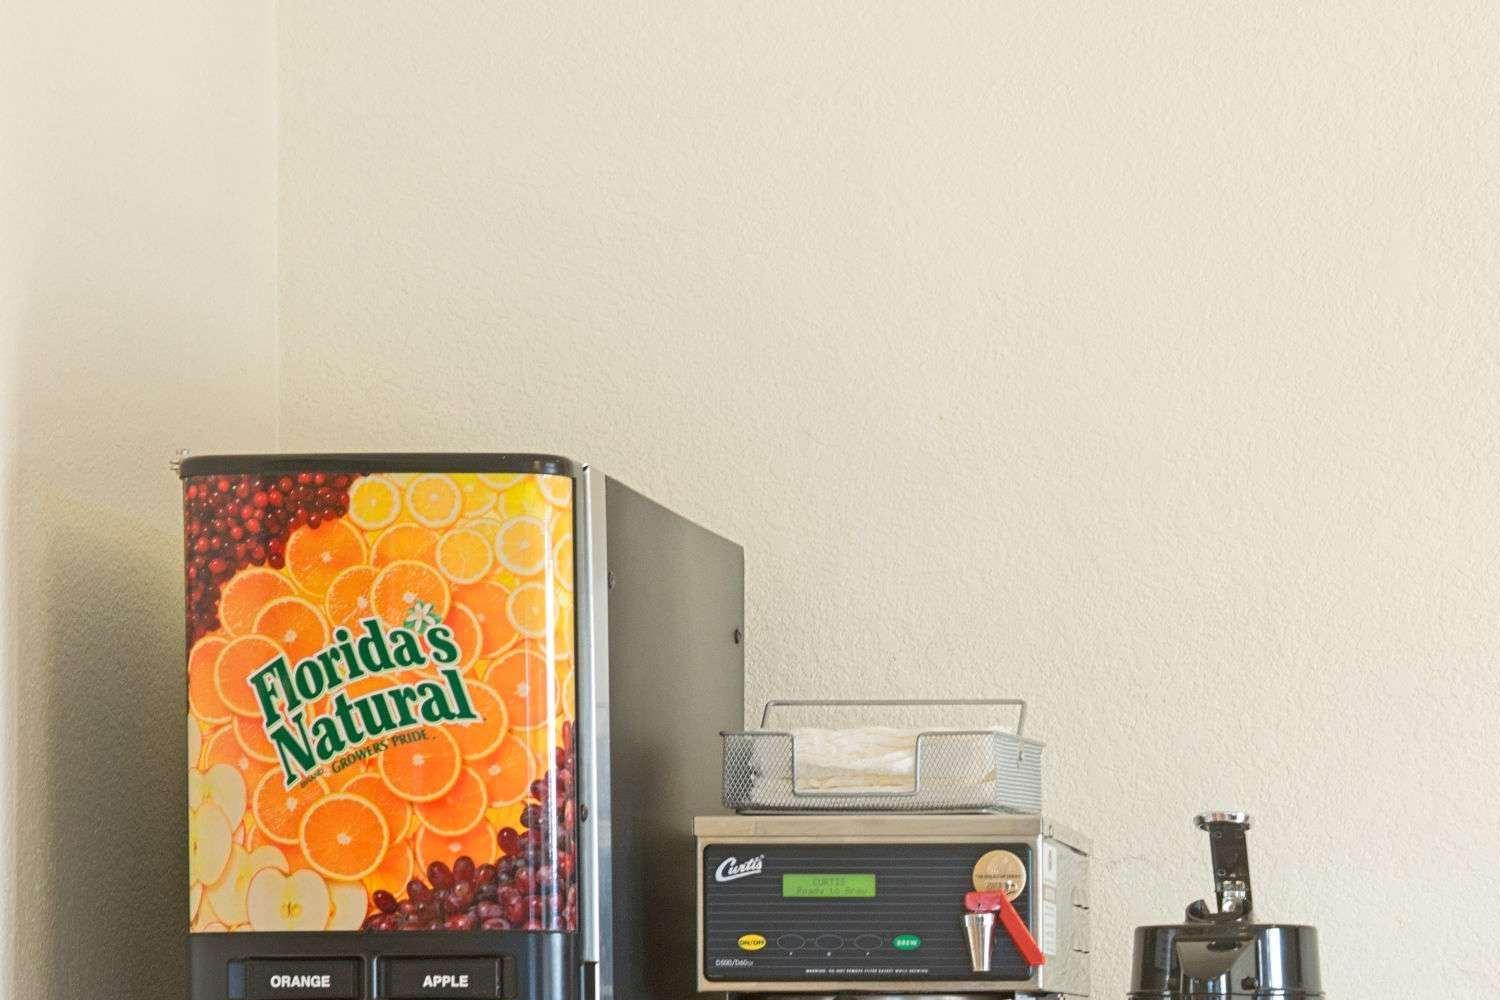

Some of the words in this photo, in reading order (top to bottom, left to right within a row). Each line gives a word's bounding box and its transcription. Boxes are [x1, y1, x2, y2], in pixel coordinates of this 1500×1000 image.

[248, 616, 459, 727] Florida's
[269, 668, 477, 787] Natural
[391, 729, 429, 749] PRIDE
[715, 855, 764, 883] Curtis
[896, 939, 918, 947] BREW
[270, 974, 331, 989] ORANGE
[422, 974, 469, 989] APPLE
